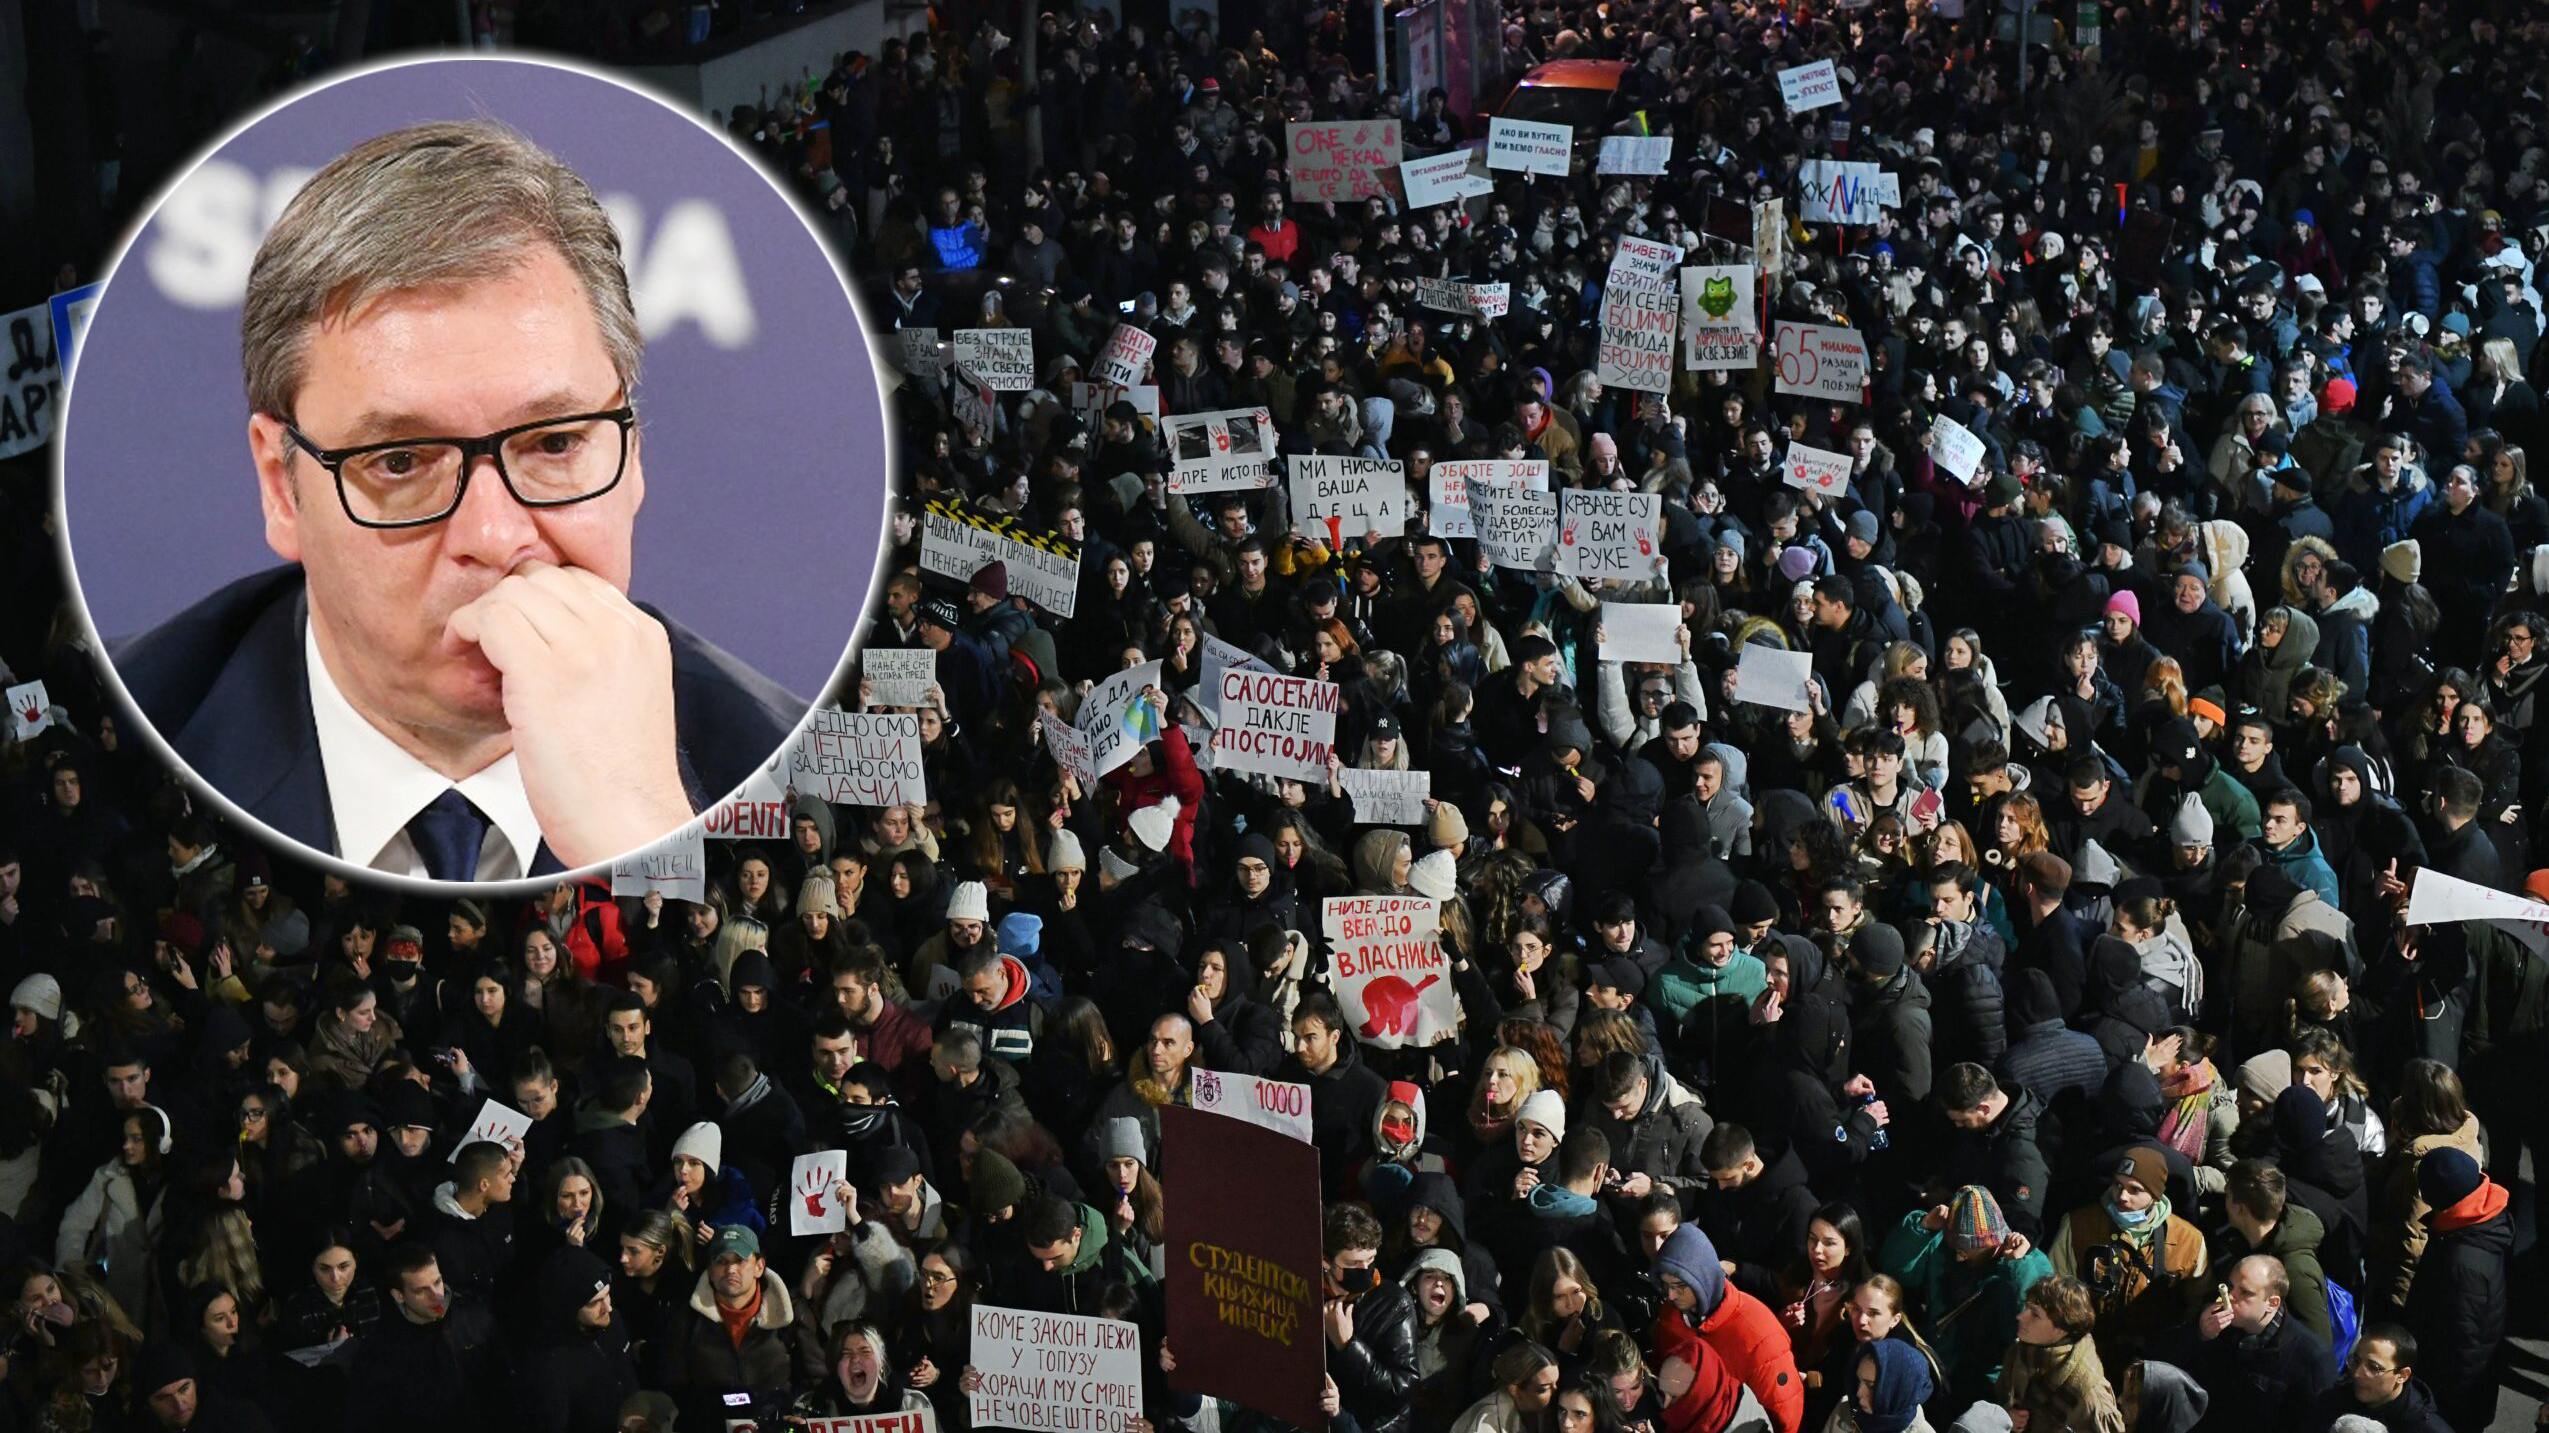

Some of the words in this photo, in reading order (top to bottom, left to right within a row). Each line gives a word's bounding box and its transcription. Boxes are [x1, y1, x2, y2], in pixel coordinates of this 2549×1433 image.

[1499, 128, 1515, 137] АКО
[1518, 129, 1529, 138] ВИ
[1494, 142, 1508, 151] МИ
[1534, 146, 1567, 157] ГЛАСНО
[1621, 240, 1676, 263] ЖИВЕТИ
[1629, 257, 1660, 273] ЗНАЧИ
[1604, 287, 1632, 307] МИ
[1635, 292, 1654, 311] СЕ
[1658, 294, 1679, 313] НЕ
[1609, 305, 1675, 334] БОЈИМО
[955, 333, 981, 345] БЕЗ
[986, 332, 1030, 346] СТРУЈЕ
[1603, 324, 1643, 348] УЧИМО
[1643, 333, 1669, 353] ДА
[974, 346, 1024, 361] ЗНАЊА
[1600, 345, 1672, 372] БРОЈИМО
[1776, 325, 1819, 386] 65
[1821, 356, 1859, 369] РАЗЛОГА
[992, 361, 1033, 375] СВЕТЛЕ
[1838, 369, 1848, 377] ЗА
[984, 376, 1033, 389] УЋНОСТИ
[1822, 378, 1862, 392] ПОБУНУ
[1182, 469, 1208, 485] ПРЕ
[1300, 459, 1327, 479] МИ
[1340, 458, 1402, 476] НИСМО
[1439, 463, 1494, 478] УБИЈТЕ
[1508, 463, 1541, 477] ЈОШ
[1318, 477, 1369, 498] ВАША
[1522, 489, 1540, 501] СЕ
[1306, 500, 1389, 520] ДЕЦА
[1503, 504, 1556, 516] БОЛЕСНУ
[1564, 494, 1623, 517] КРВАВЕ
[1629, 494, 1650, 518] СУ
[1489, 516, 1508, 529] ДА
[1511, 516, 1558, 531] ВОЗИМ
[1591, 520, 1626, 542] ВАМ
[925, 514, 963, 545] ЧОВЕКА
[1000, 535, 1036, 563] ГОРАНА
[1037, 550, 1077, 583] ЈЕШИЋА
[1487, 529, 1542, 544] ВРТИЋ
[922, 548, 974, 578] ТРЕНЕРА
[979, 551, 996, 563] ЗА
[1511, 547, 1533, 562] ЈЕ
[1578, 546, 1630, 571] РУКЕ
[900, 660, 910, 671] НЕ
[912, 660, 931, 670] СМЕ
[905, 670, 927, 680] ПРЕД
[1106, 679, 1129, 708] ДА
[806, 710, 870, 736] ЈЕДНО
[875, 715, 918, 738] СМО
[1245, 706, 1310, 735] ДАКЛЕ
[797, 731, 903, 761] ЛЕПШИ
[1048, 727, 1089, 760] DIPLOME
[1221, 726, 1334, 767] ПОСТОЈИМ
[794, 752, 874, 778] ЗАЈЕДНО
[878, 760, 919, 780] СМО
[818, 777, 902, 806] ЈАЧИ
[704, 801, 786, 838] UDENTI
[1328, 900, 1374, 916] НИЈЕ
[1376, 900, 1400, 915] ДО
[1402, 900, 1432, 911] ПСА
[1343, 917, 1374, 940] ВЕЋ
[1383, 915, 1412, 937] ДО
[1337, 940, 1444, 978] ВЛАСНИКА
[1256, 1080, 1303, 1117] 1000
[1189, 1241, 1313, 1308] СТУДЕНТСКА
[1204, 1272, 1298, 1328] КЊИЖИЦА
[977, 1312, 1025, 1342] КОМЕ
[1030, 1317, 1087, 1347] ЗАКОН
[1094, 1323, 1136, 1351] ЛЕЖИ
[1218, 1301, 1293, 1346] ИНДЕКС
[1011, 1347, 1023, 1368] У
[1036, 1348, 1098, 1376] ТОПУЗУ
[975, 1372, 1046, 1400] КОРАЦИ
[1053, 1375, 1076, 1401] МУ
[1081, 1382, 1137, 1409] СМРДЕ
